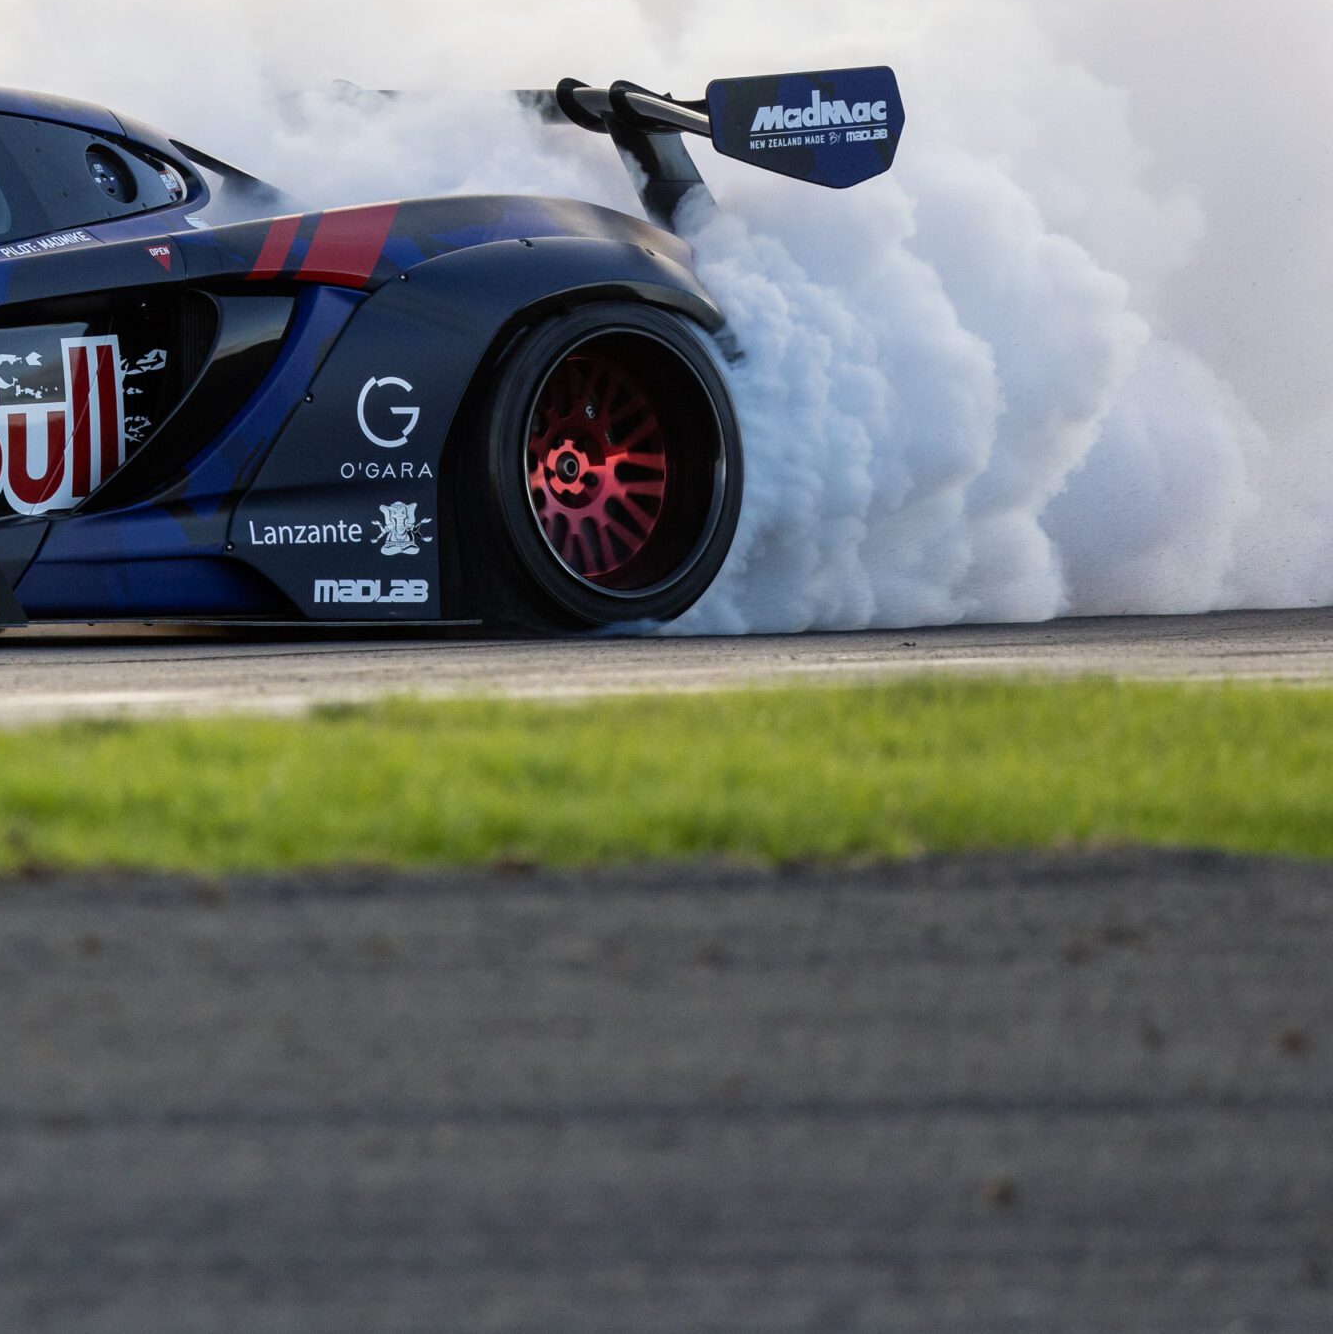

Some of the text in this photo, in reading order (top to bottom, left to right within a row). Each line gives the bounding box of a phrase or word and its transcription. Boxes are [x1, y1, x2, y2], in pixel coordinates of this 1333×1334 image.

[750, 89, 887, 132] MadMac
[749, 139, 766, 150] NEW
[768, 136, 802, 148] ZEALAND
[804, 134, 826, 145] MADE
[845, 128, 888, 142] MADLAB
[0, 231, 91, 258] PILOT: MADMIKE
[148, 246, 171, 257] OPEN
[340, 462, 433, 479] O'GARA
[248, 519, 363, 546] Lanzante
[313, 579, 429, 603] MADLAB
